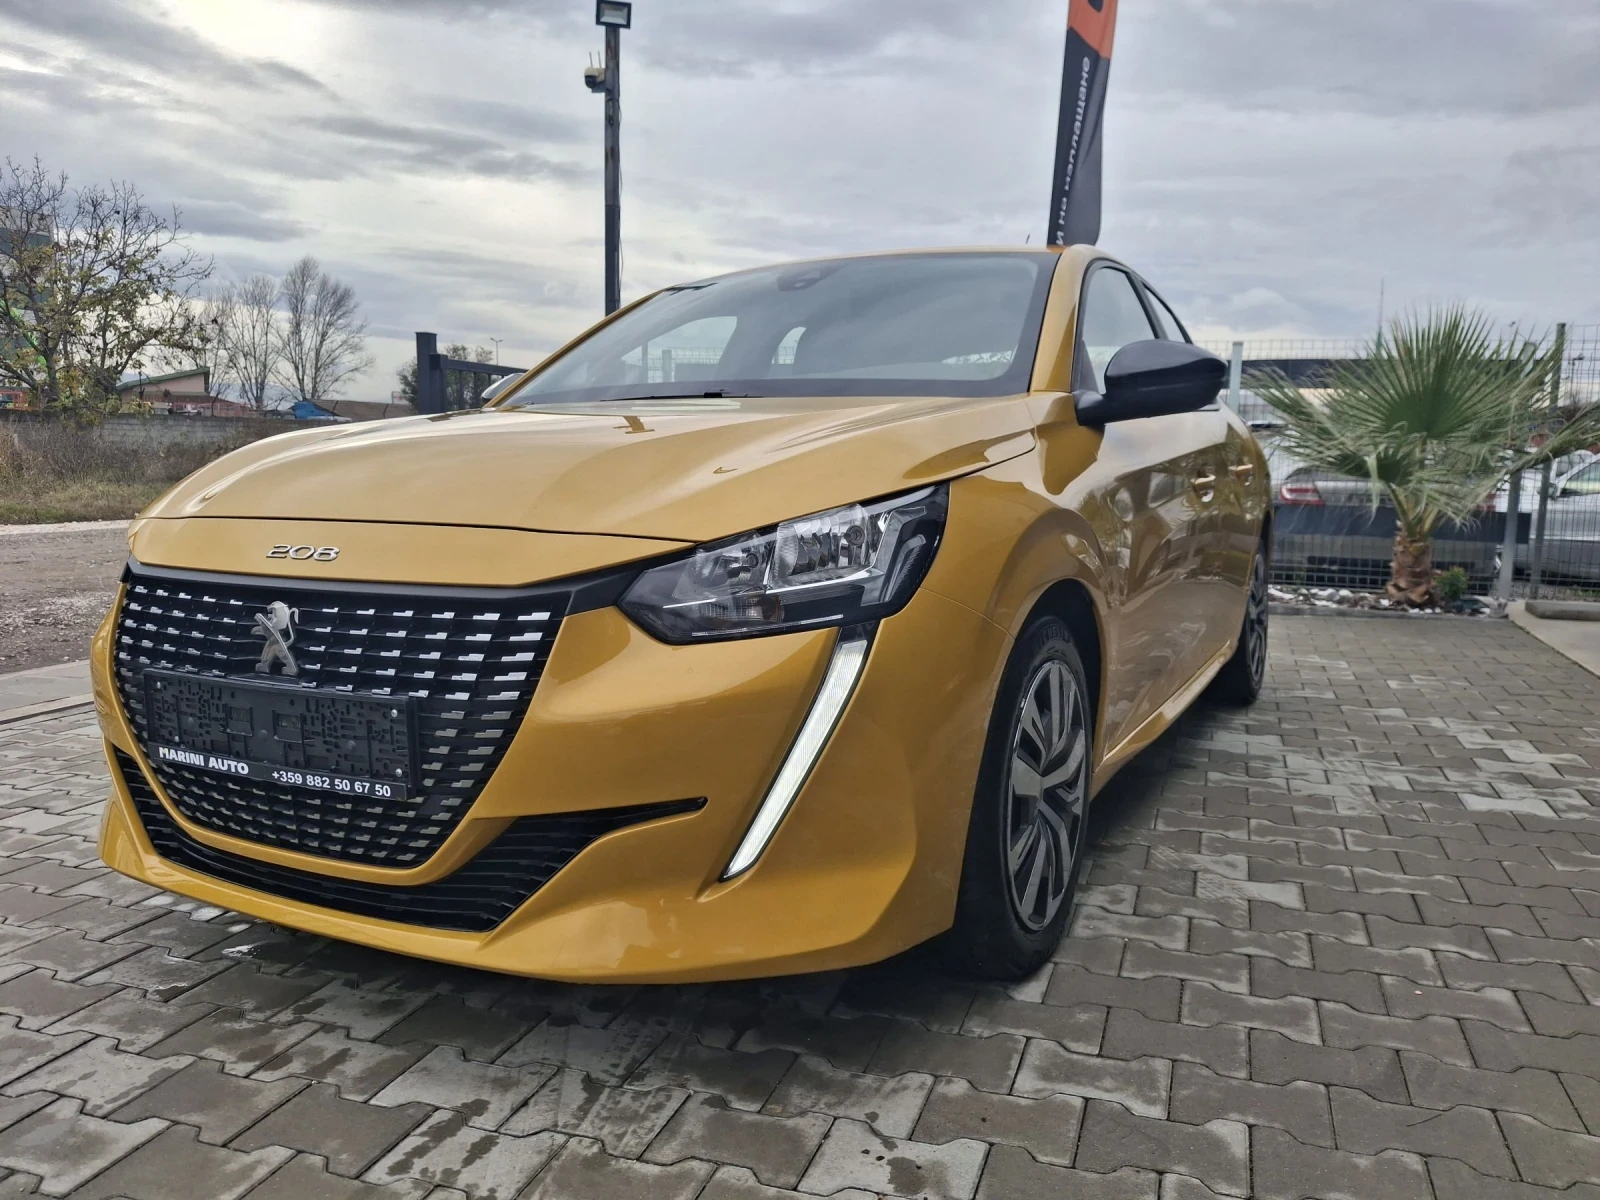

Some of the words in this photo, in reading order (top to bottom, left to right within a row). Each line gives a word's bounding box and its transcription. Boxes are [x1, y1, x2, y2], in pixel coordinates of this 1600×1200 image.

[1058, 197, 1067, 225] на
[265, 544, 340, 562] 208
[158, 747, 204, 766] MARINI
[208, 757, 249, 775] AUTO
[271, 770, 303, 784] +359
[306, 774, 331, 788] 882
[334, 778, 351, 791] 50
[354, 781, 371, 794] 67
[374, 784, 391, 797] 50
